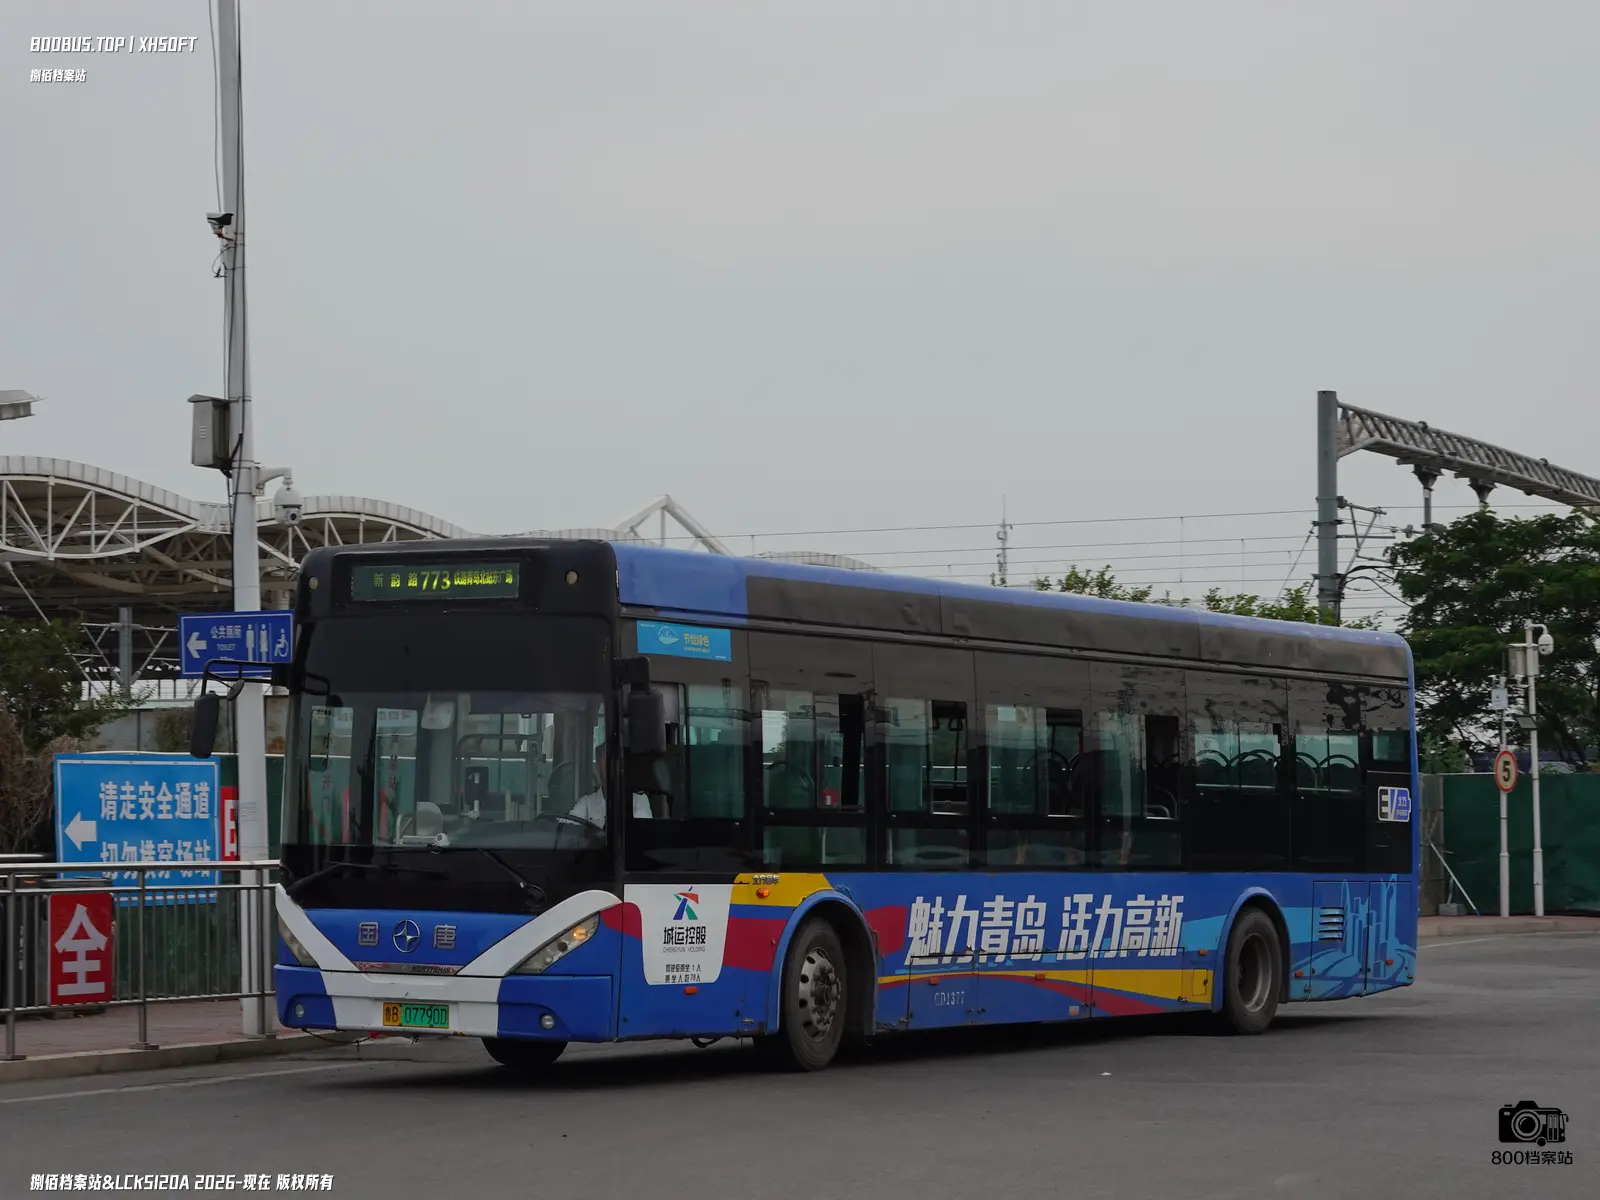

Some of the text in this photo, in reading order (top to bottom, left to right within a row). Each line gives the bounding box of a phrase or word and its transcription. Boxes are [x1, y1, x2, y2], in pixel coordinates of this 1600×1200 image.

[421, 571, 451, 590] 773
[1502, 761, 1511, 782] 5
[98, 781, 210, 821] 请走安全通道
[358, 921, 379, 946] 国
[663, 926, 706, 945] 城运控股
[904, 893, 1184, 965] 魅力青岛 活力高新
[54, 903, 108, 996] 全
